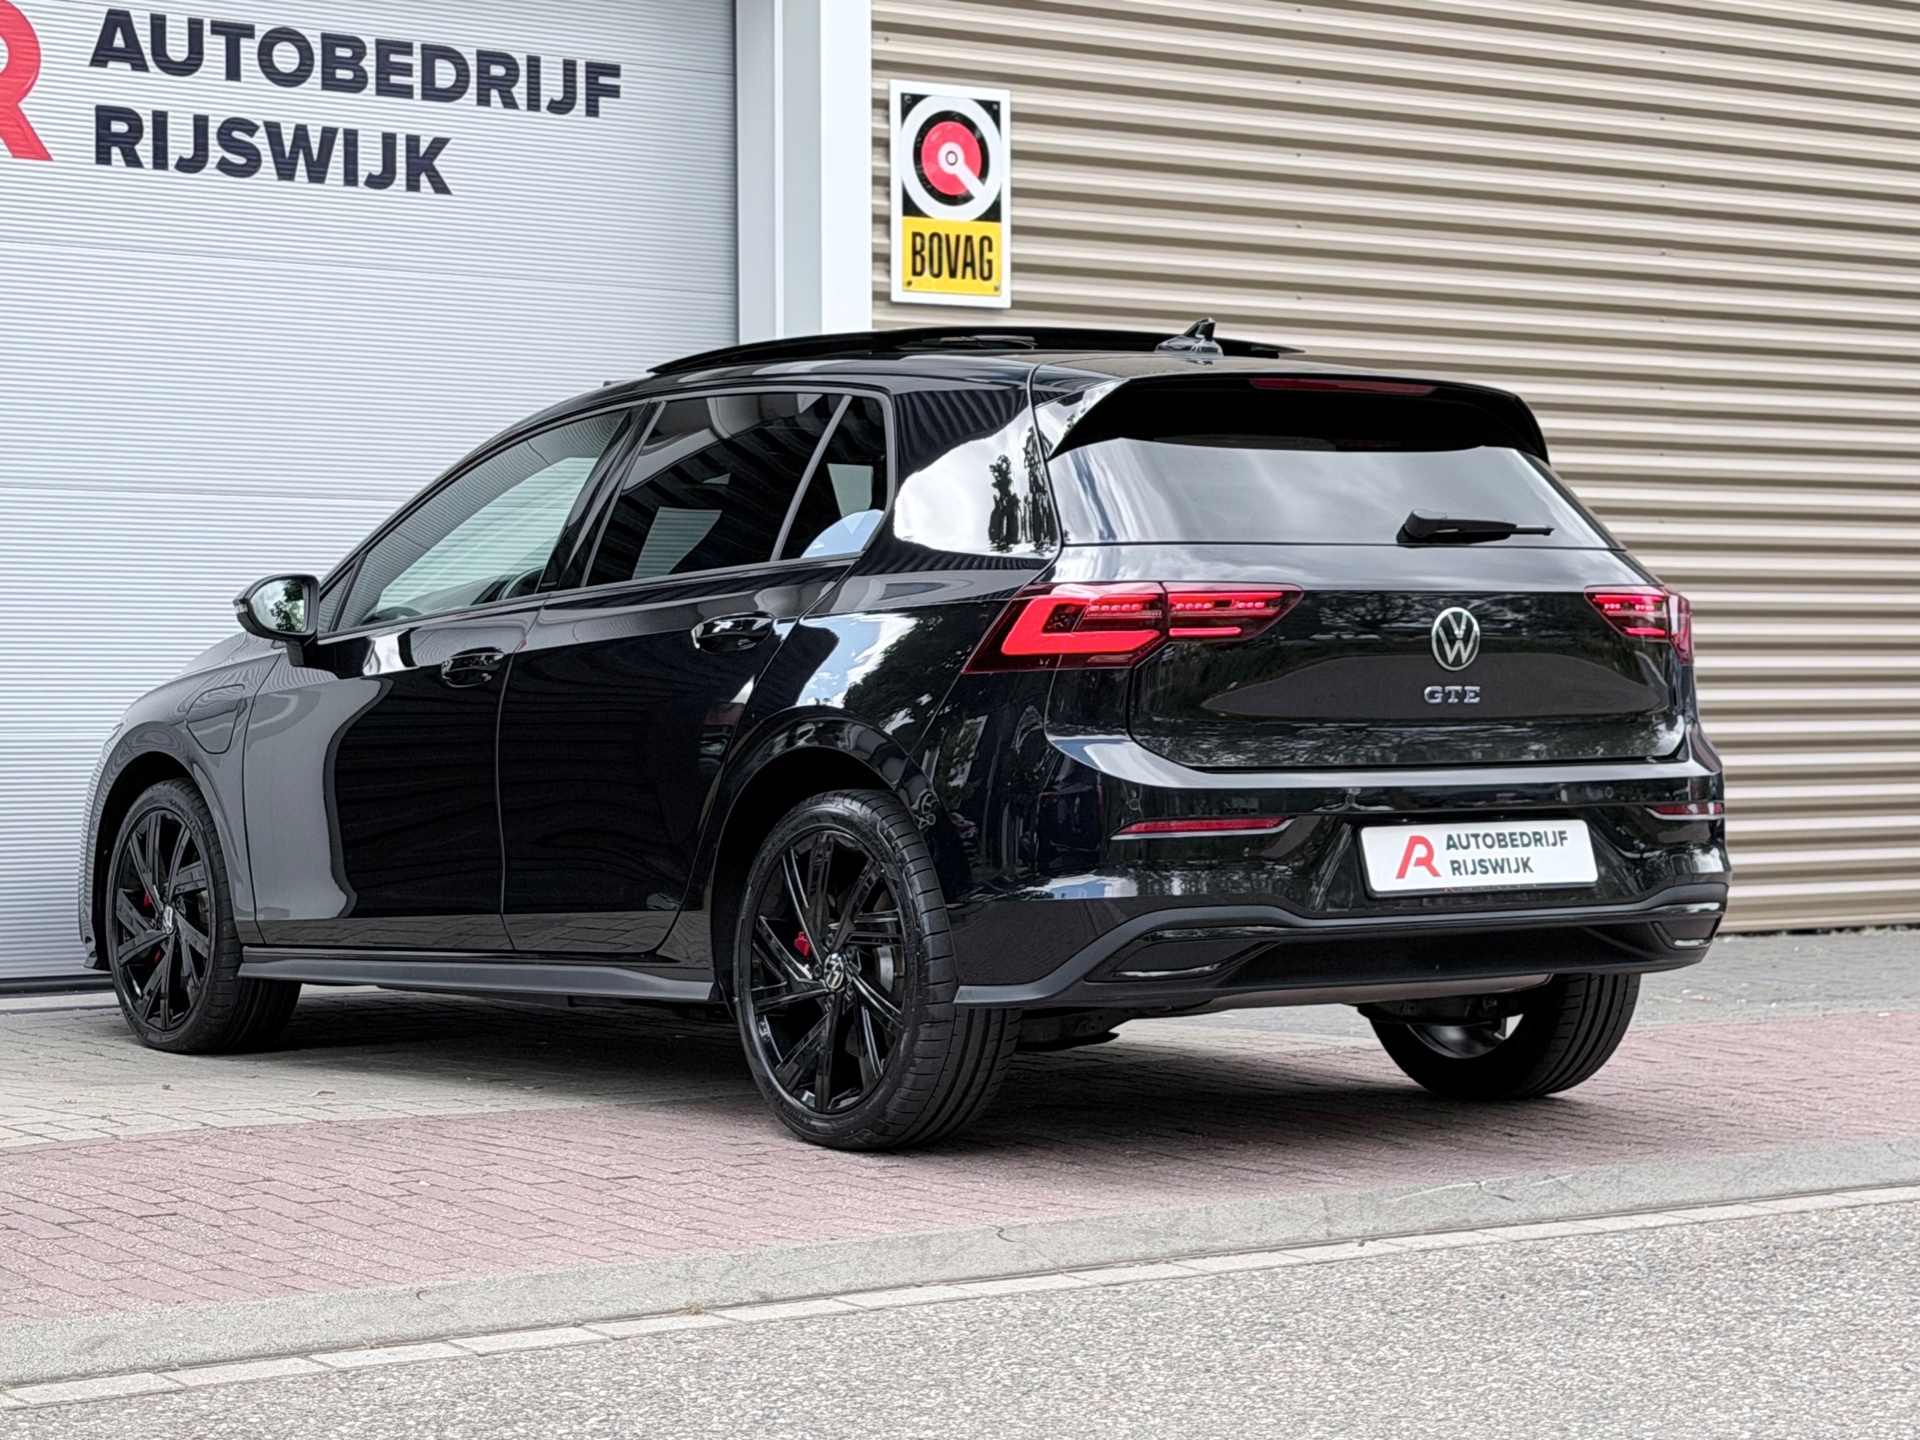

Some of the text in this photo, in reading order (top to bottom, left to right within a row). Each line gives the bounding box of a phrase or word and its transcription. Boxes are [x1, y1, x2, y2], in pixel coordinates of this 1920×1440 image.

[89, 8, 622, 118] AUTOBEDRIJF
[94, 104, 453, 195] RIJSWIJK
[911, 231, 993, 281] BOVAG
[1423, 685, 1481, 704] GTE
[1445, 830, 1569, 851] AUTOBEDRIJF
[1449, 857, 1534, 876] RIJSWIJK
